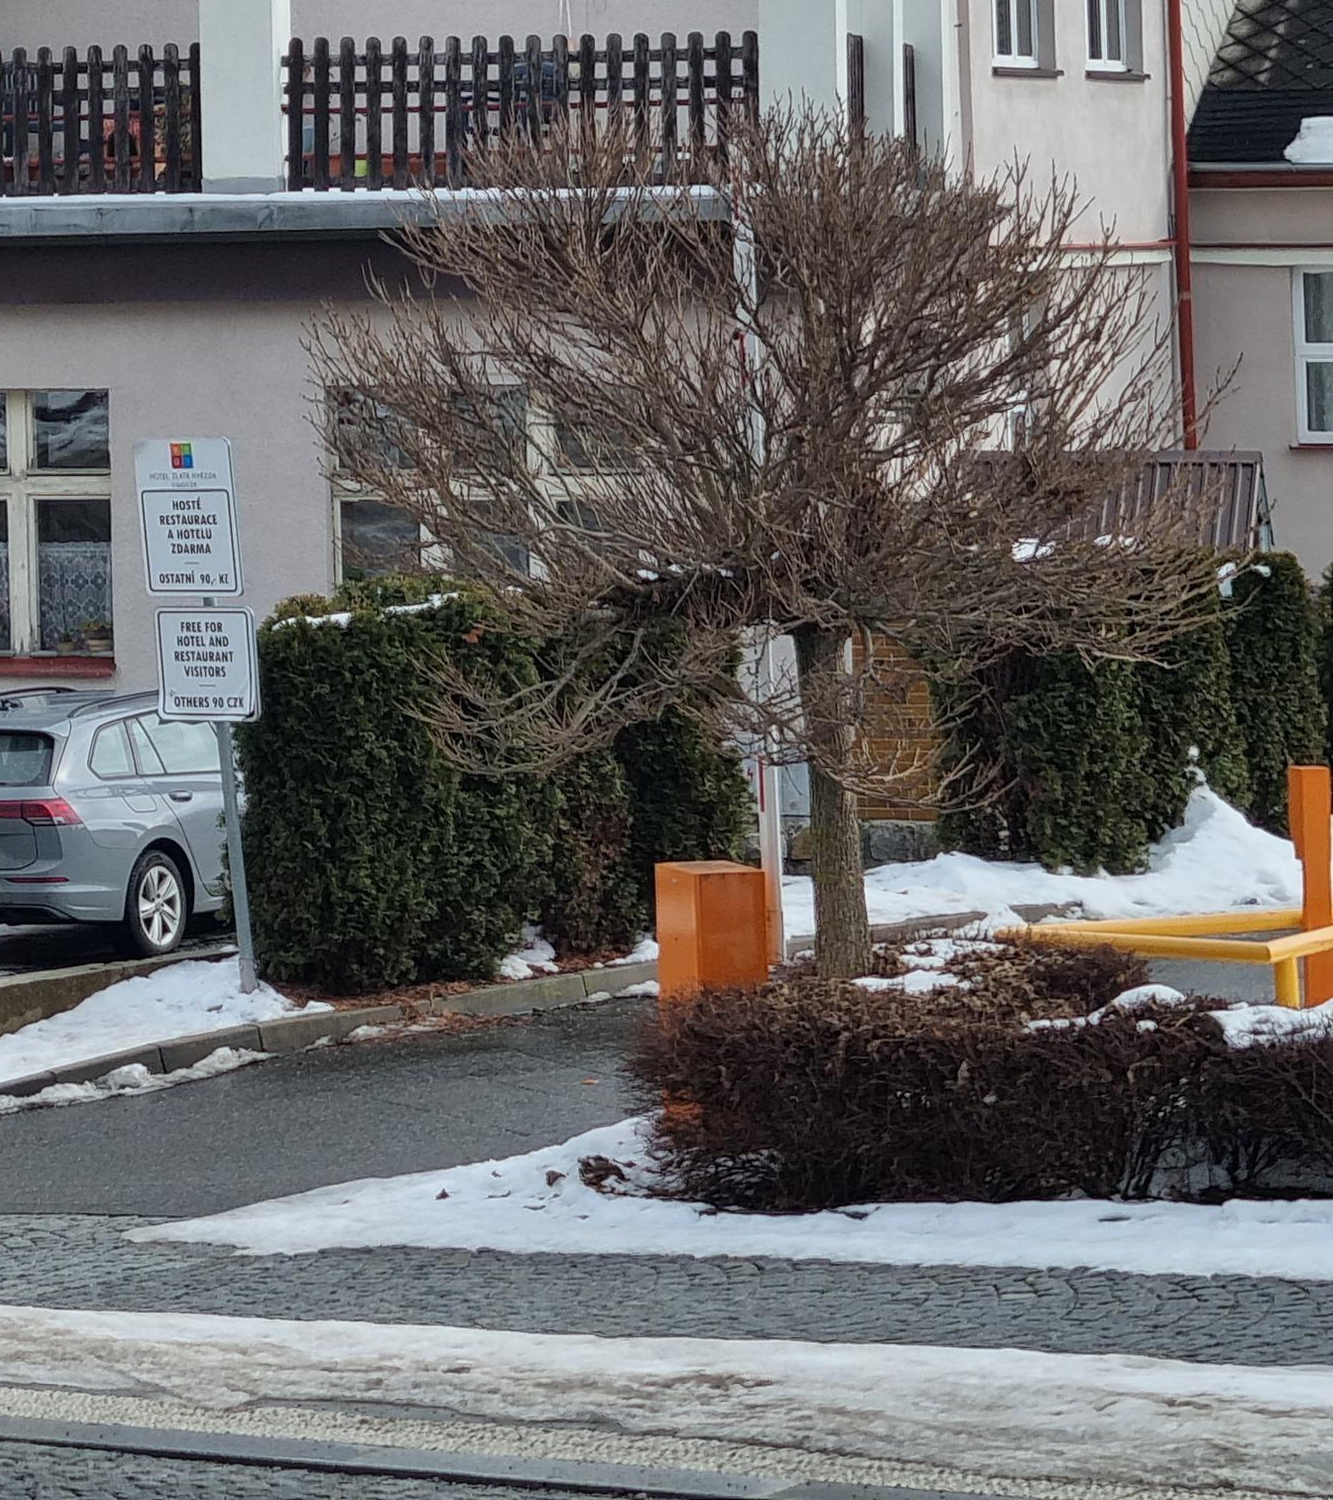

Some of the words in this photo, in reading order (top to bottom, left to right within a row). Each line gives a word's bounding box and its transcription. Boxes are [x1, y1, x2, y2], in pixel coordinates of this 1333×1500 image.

[172, 496, 202, 510] HOSTÉ
[159, 514, 218, 526] RESTAURACE
[167, 528, 174, 540] A
[177, 528, 212, 540] HOTELU
[170, 543, 212, 554] ZDARMA
[159, 570, 195, 584] OSTATNÍ
[180, 621, 202, 633] FREE
[205, 621, 223, 633] FOR
[176, 635, 206, 647] HOTEL
[209, 636, 229, 647] AND
[174, 651, 234, 662] RESTAURANT
[183, 665, 227, 678] VISITORS
[173, 696, 210, 708] OTHERS
[212, 696, 224, 708] 90
[226, 696, 245, 709] CZK
